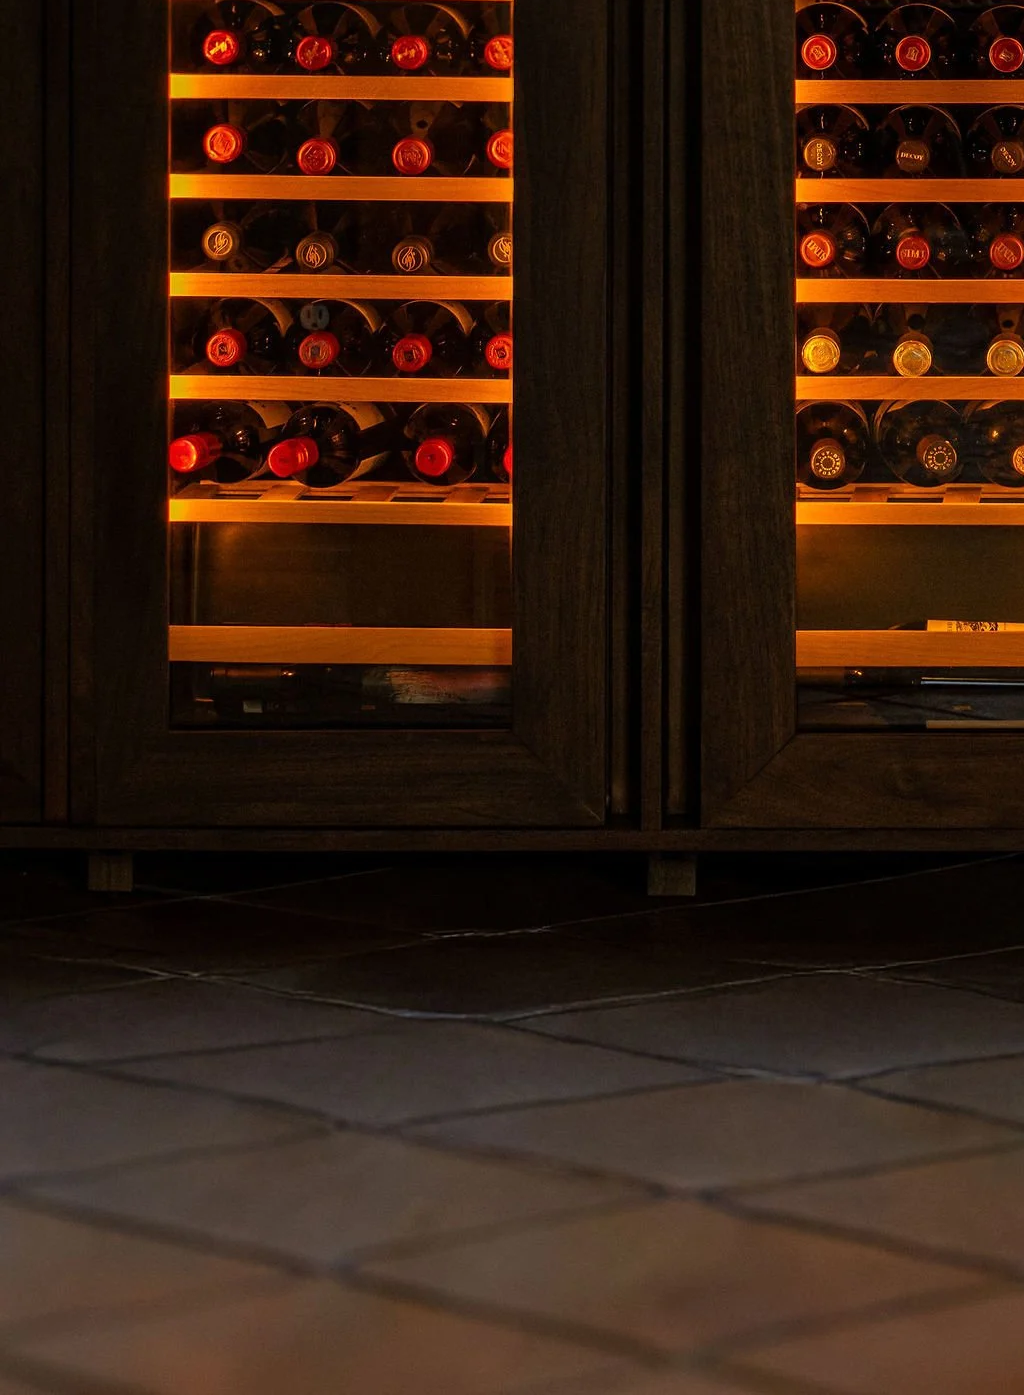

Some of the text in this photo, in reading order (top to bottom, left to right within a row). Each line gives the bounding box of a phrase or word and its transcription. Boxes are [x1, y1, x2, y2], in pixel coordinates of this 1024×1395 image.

[816, 142, 824, 166] DECOY
[900, 151, 924, 161] DECOY
[1000, 146, 1017, 167] DECOY
[806, 239, 828, 262] SIMI
[901, 249, 925, 259] SIMI
[995, 242, 1018, 263] SIMI
